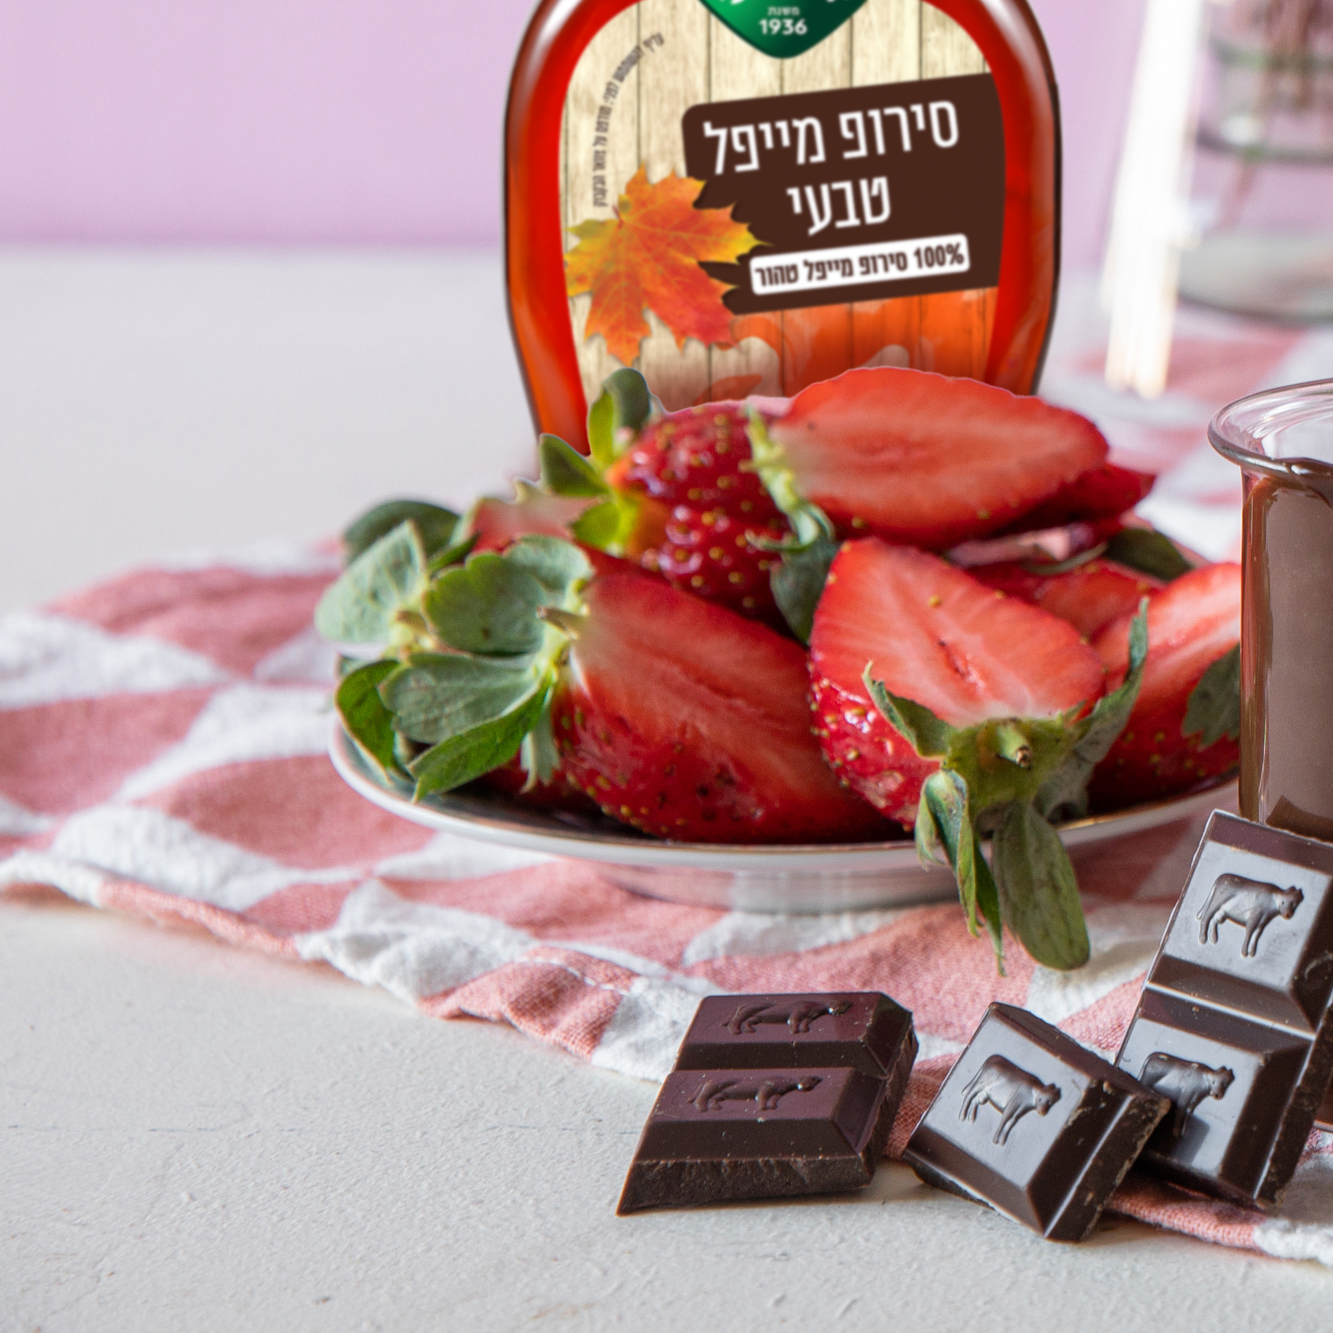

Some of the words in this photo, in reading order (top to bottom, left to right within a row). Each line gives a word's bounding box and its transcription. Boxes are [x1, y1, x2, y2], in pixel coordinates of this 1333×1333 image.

[758, 18, 808, 35] 1936
[838, 100, 959, 159] סירופ
[703, 116, 826, 175] מייפל
[786, 176, 891, 236] טבעי
[858, 252, 908, 276] סירופ
[913, 242, 965, 269] 100%
[755, 264, 800, 288] טהור
[802, 258, 854, 283] מייפל
